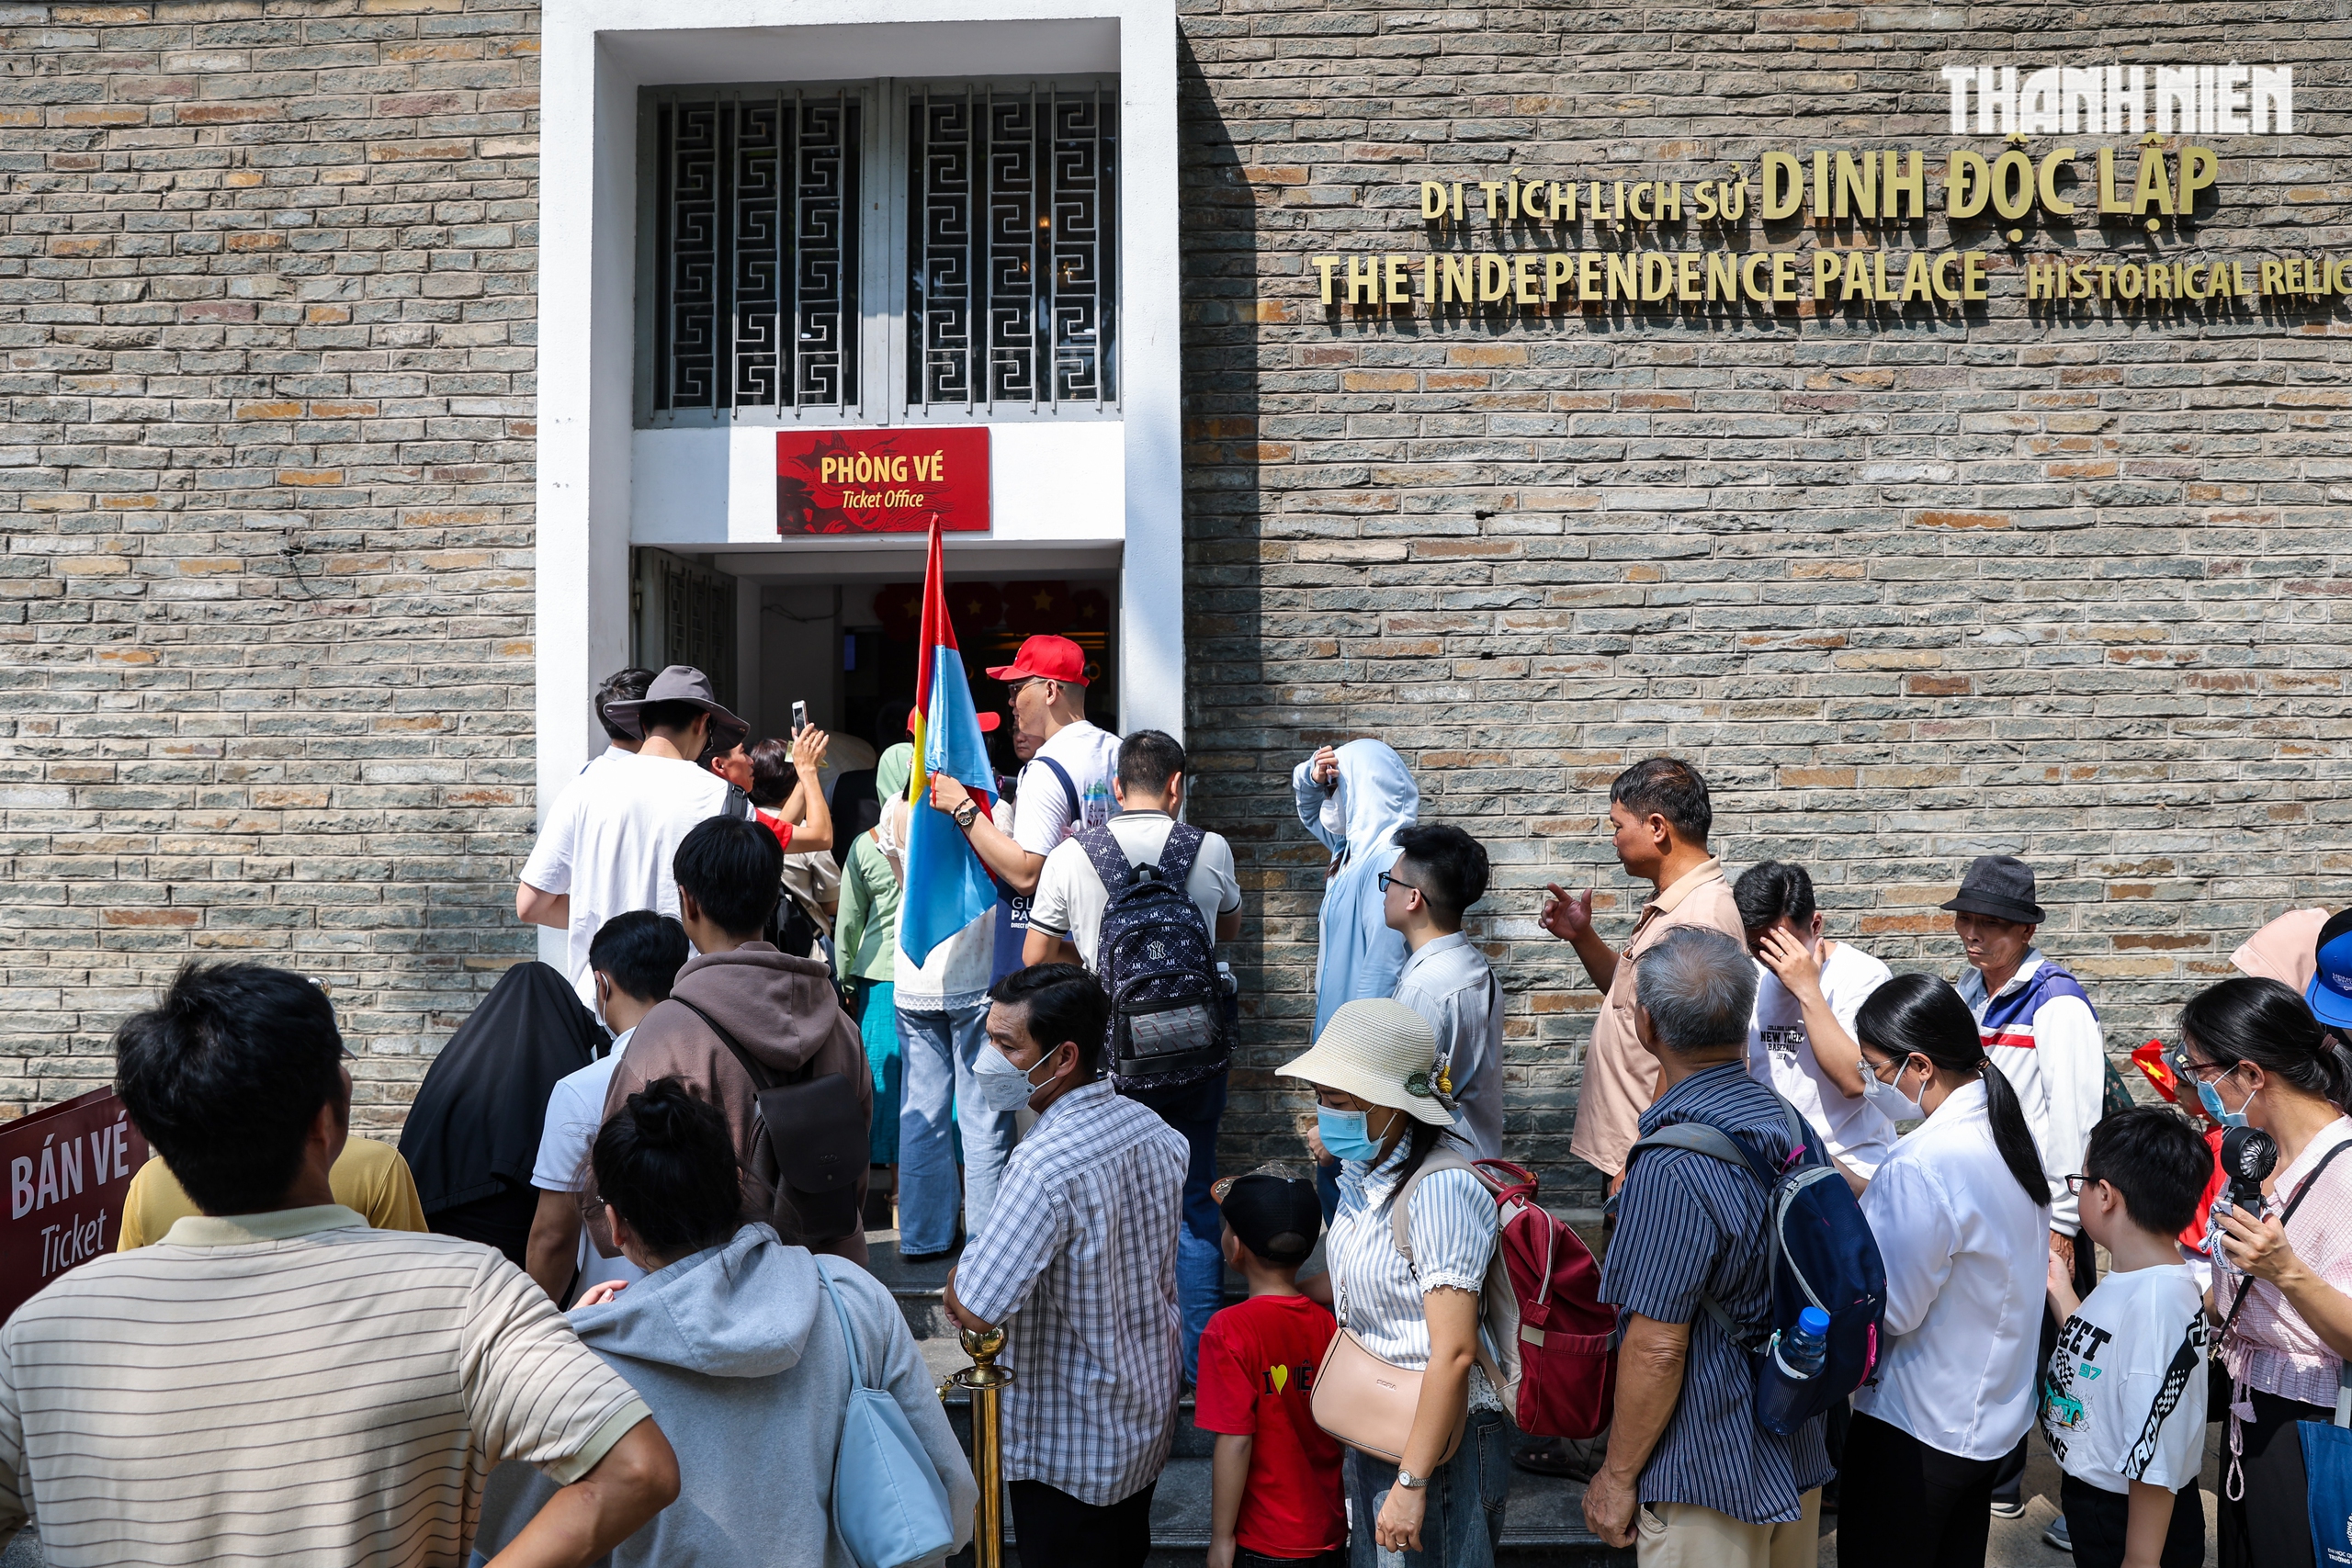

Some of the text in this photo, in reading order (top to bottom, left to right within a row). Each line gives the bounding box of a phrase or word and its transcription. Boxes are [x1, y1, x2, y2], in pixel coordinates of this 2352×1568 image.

[1420, 131, 2218, 243] DI TÍCH LỊCH SỬ DINH ĐỘC LẬP
[1311, 251, 2352, 305] THE INDEPENDENCE PALACE HISTORICAL RELIC
[820, 449, 944, 484] PHÒNG VÉ
[842, 489, 924, 509] Ticket Office
[1760, 1031, 1804, 1044] NEW YORK
[1768, 1043, 1796, 1053] BASEBALL
[11, 1109, 130, 1221] BÁN VÉ
[40, 1208, 107, 1278] Ticket
[2058, 1314, 2113, 1362] EET
[2078, 1362, 2103, 1381] 97
